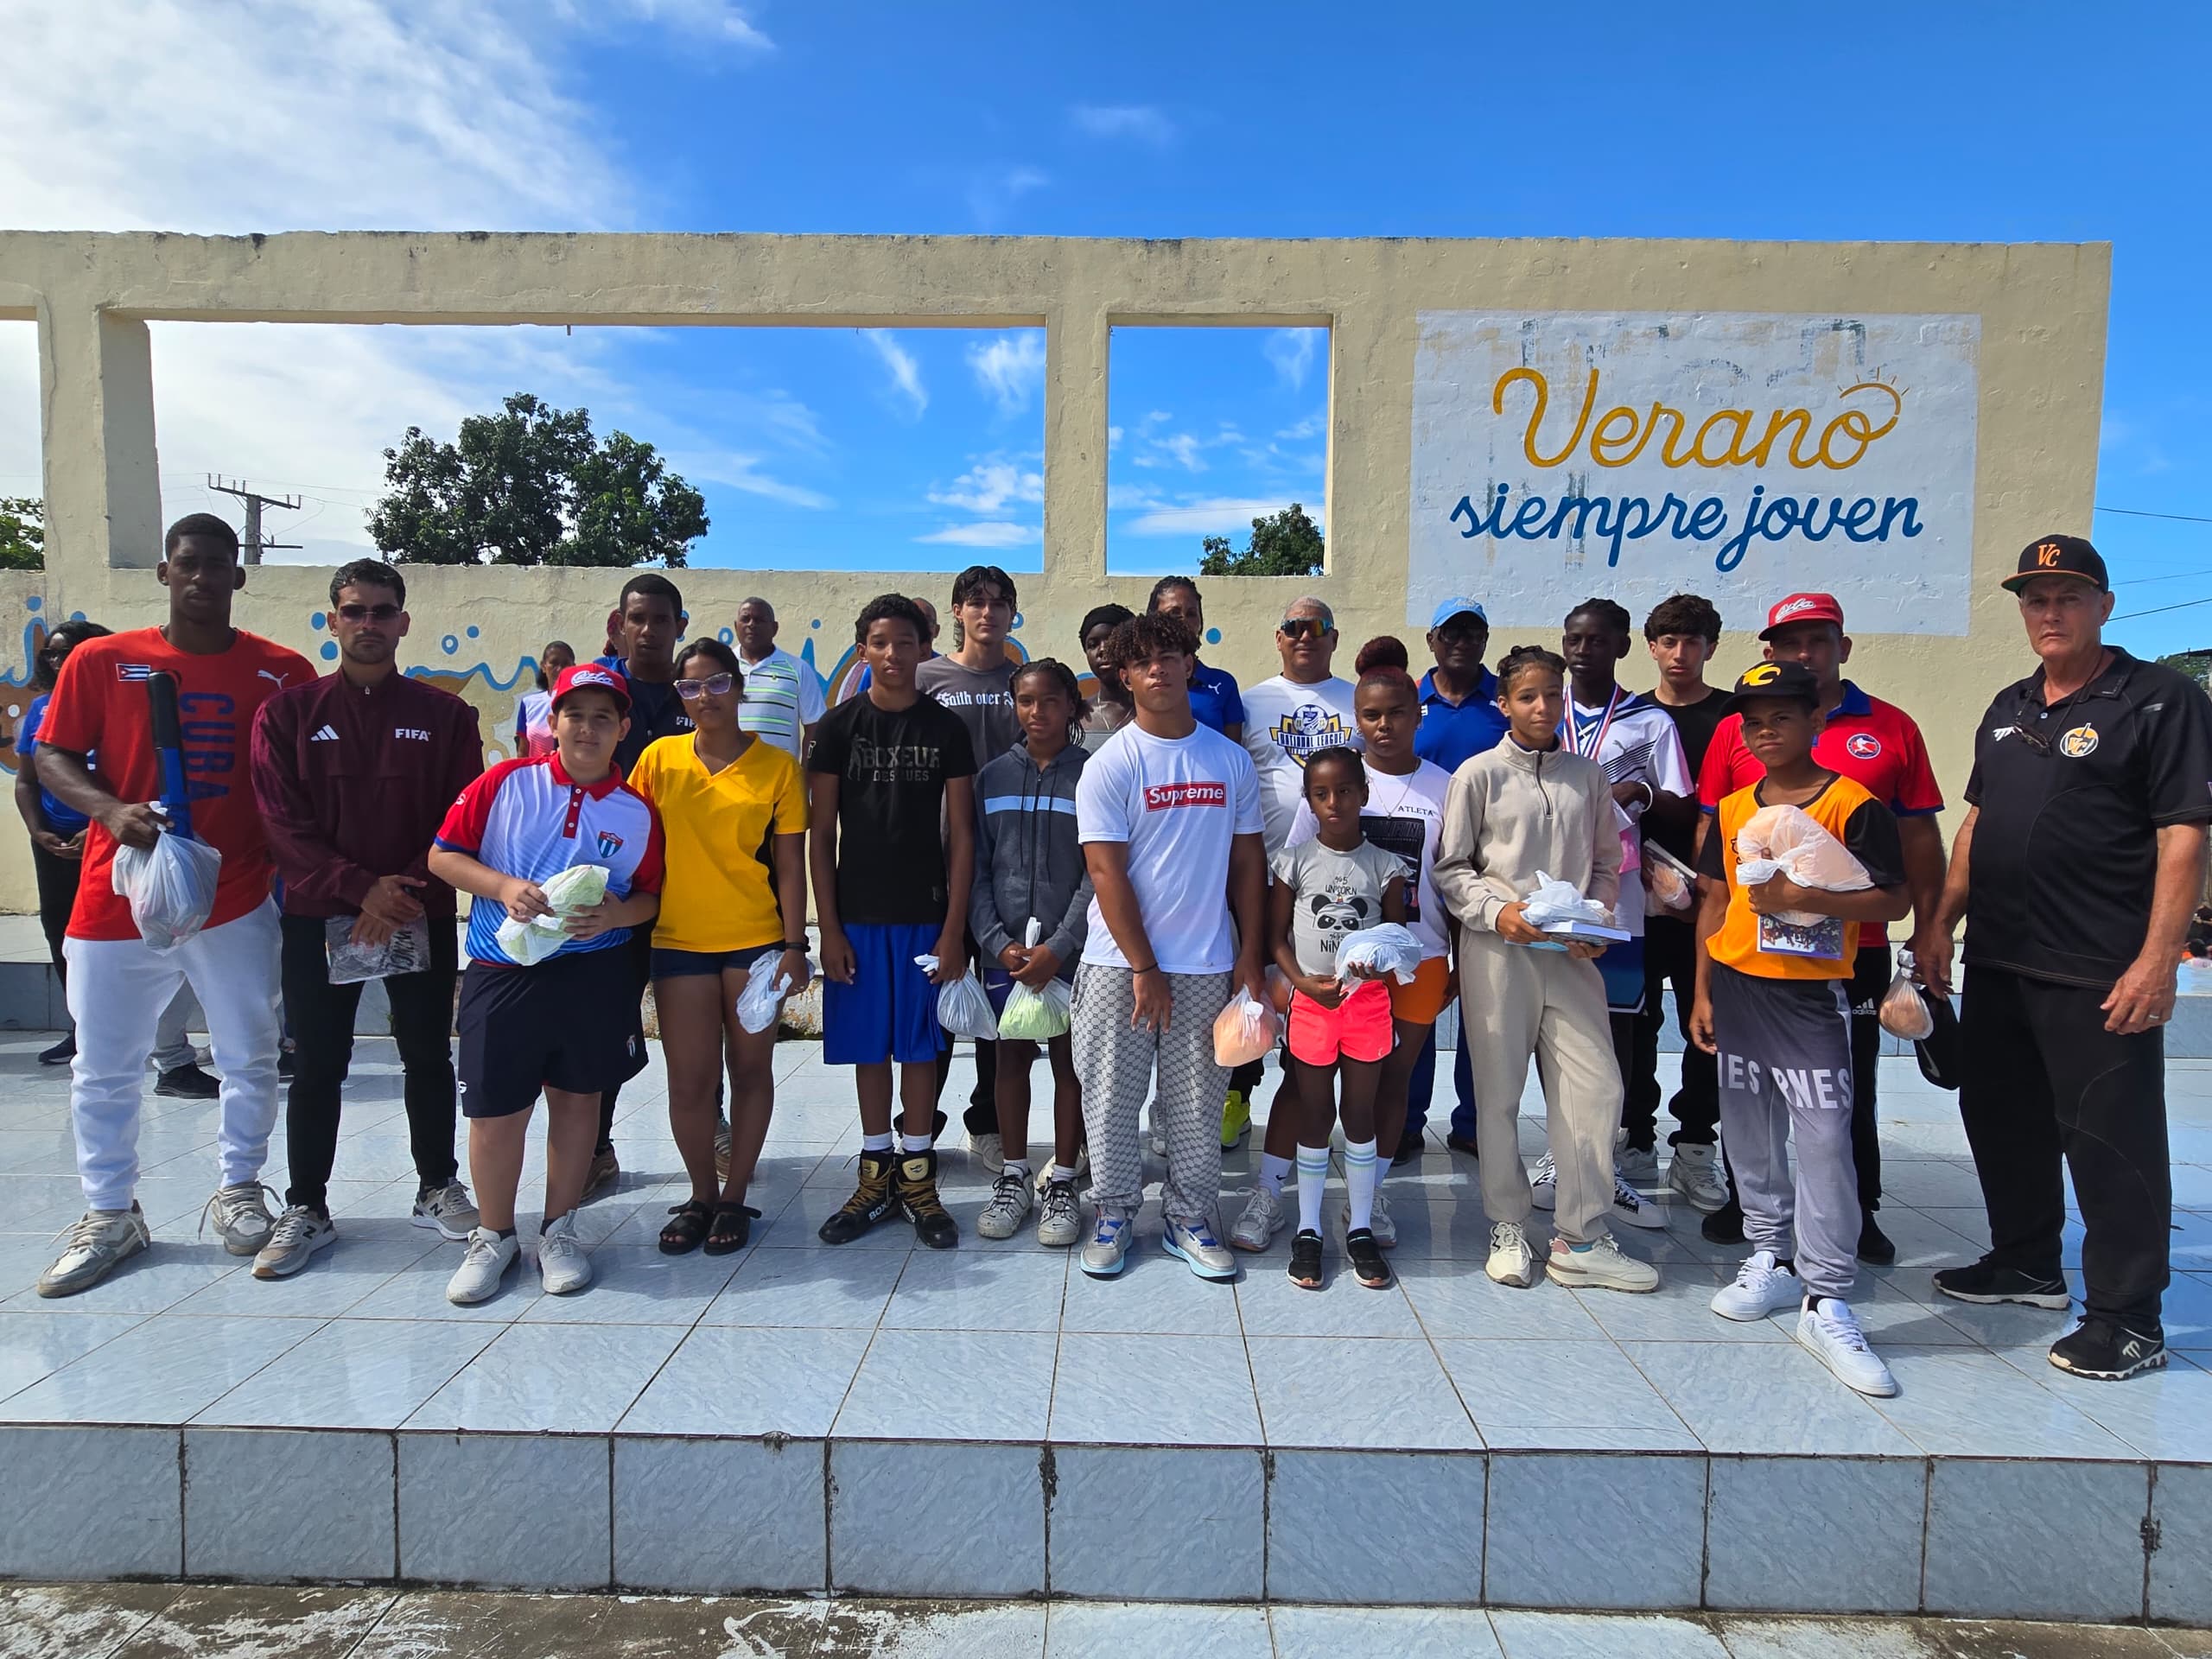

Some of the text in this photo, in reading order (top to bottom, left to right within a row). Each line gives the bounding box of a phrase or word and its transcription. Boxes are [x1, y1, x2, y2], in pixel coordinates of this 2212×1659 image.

[1493, 367, 1898, 469] Verano
[1450, 483, 1923, 572] siempre joven
[2038, 543, 2061, 567] VC
[935, 691, 973, 708] Faith
[976, 693, 1001, 705] over
[677, 716, 697, 728] FIF
[395, 728, 429, 741] FIFA
[179, 692, 235, 801] CUBA
[900, 770, 930, 782] UES
[1149, 787, 1224, 805] Supreme
[1397, 805, 1434, 817] ATLETA
